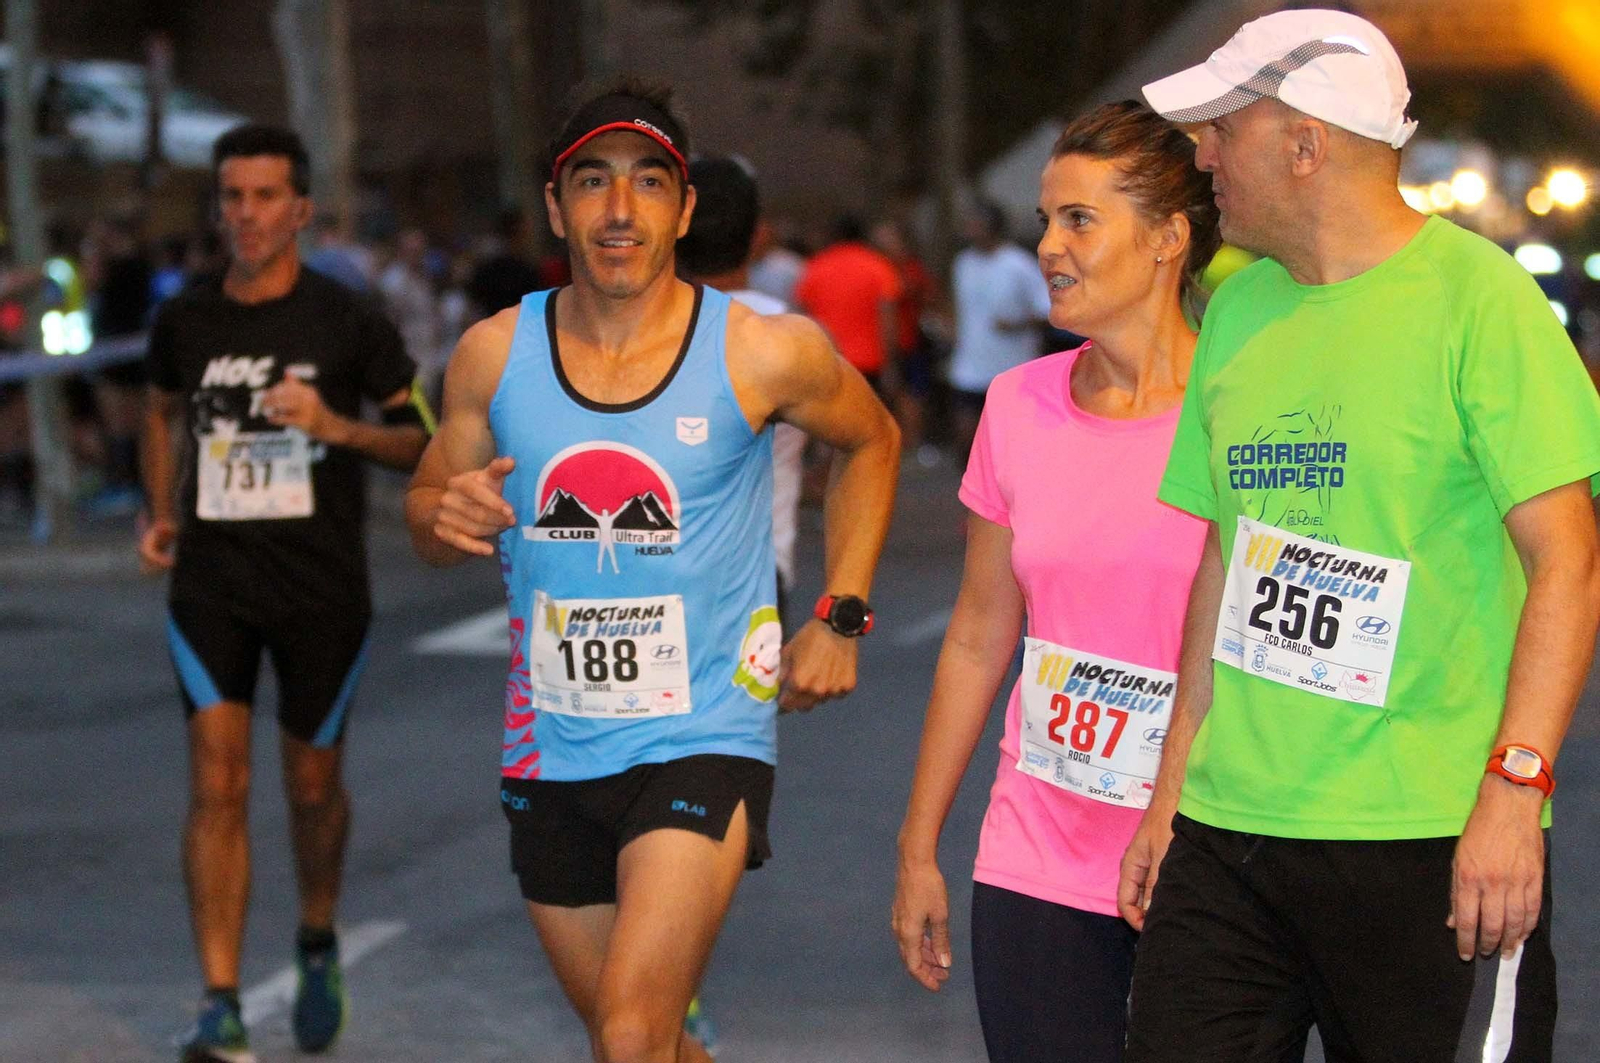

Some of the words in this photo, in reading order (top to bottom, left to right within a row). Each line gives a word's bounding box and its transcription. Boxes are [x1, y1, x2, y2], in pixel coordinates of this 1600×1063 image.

[1227, 442, 1348, 466] CORREDOR
[1229, 467, 1345, 490] COMPLETO
[548, 530, 596, 540] CLUB
[615, 532, 645, 543] Ultra
[649, 532, 673, 543] Trail
[635, 546, 674, 556] HUELVA
[1245, 533, 1283, 575] VII
[1279, 543, 1389, 584] NOCTURNA
[1272, 560, 1299, 581] DE
[1299, 568, 1380, 603] HUELVA
[569, 604, 665, 623] NOCTURNA
[1248, 576, 1343, 650] 256
[565, 621, 590, 638] DE
[594, 620, 662, 638] HUELVA
[1352, 633, 1389, 645] HYUNDAI
[1264, 633, 1279, 646] FCO
[1282, 639, 1313, 657] CARLOS
[557, 639, 639, 683] 188
[1266, 665, 1291, 678] HUELVA
[1036, 653, 1073, 691] VII
[1070, 661, 1175, 697] NOCTURNA
[1297, 675, 1337, 692] SportJobs
[584, 683, 611, 692] SERGIO
[1063, 677, 1092, 697] DE
[1091, 685, 1165, 715] HUELVA
[1047, 693, 1130, 760] 287
[1068, 749, 1091, 765] ROCIO
